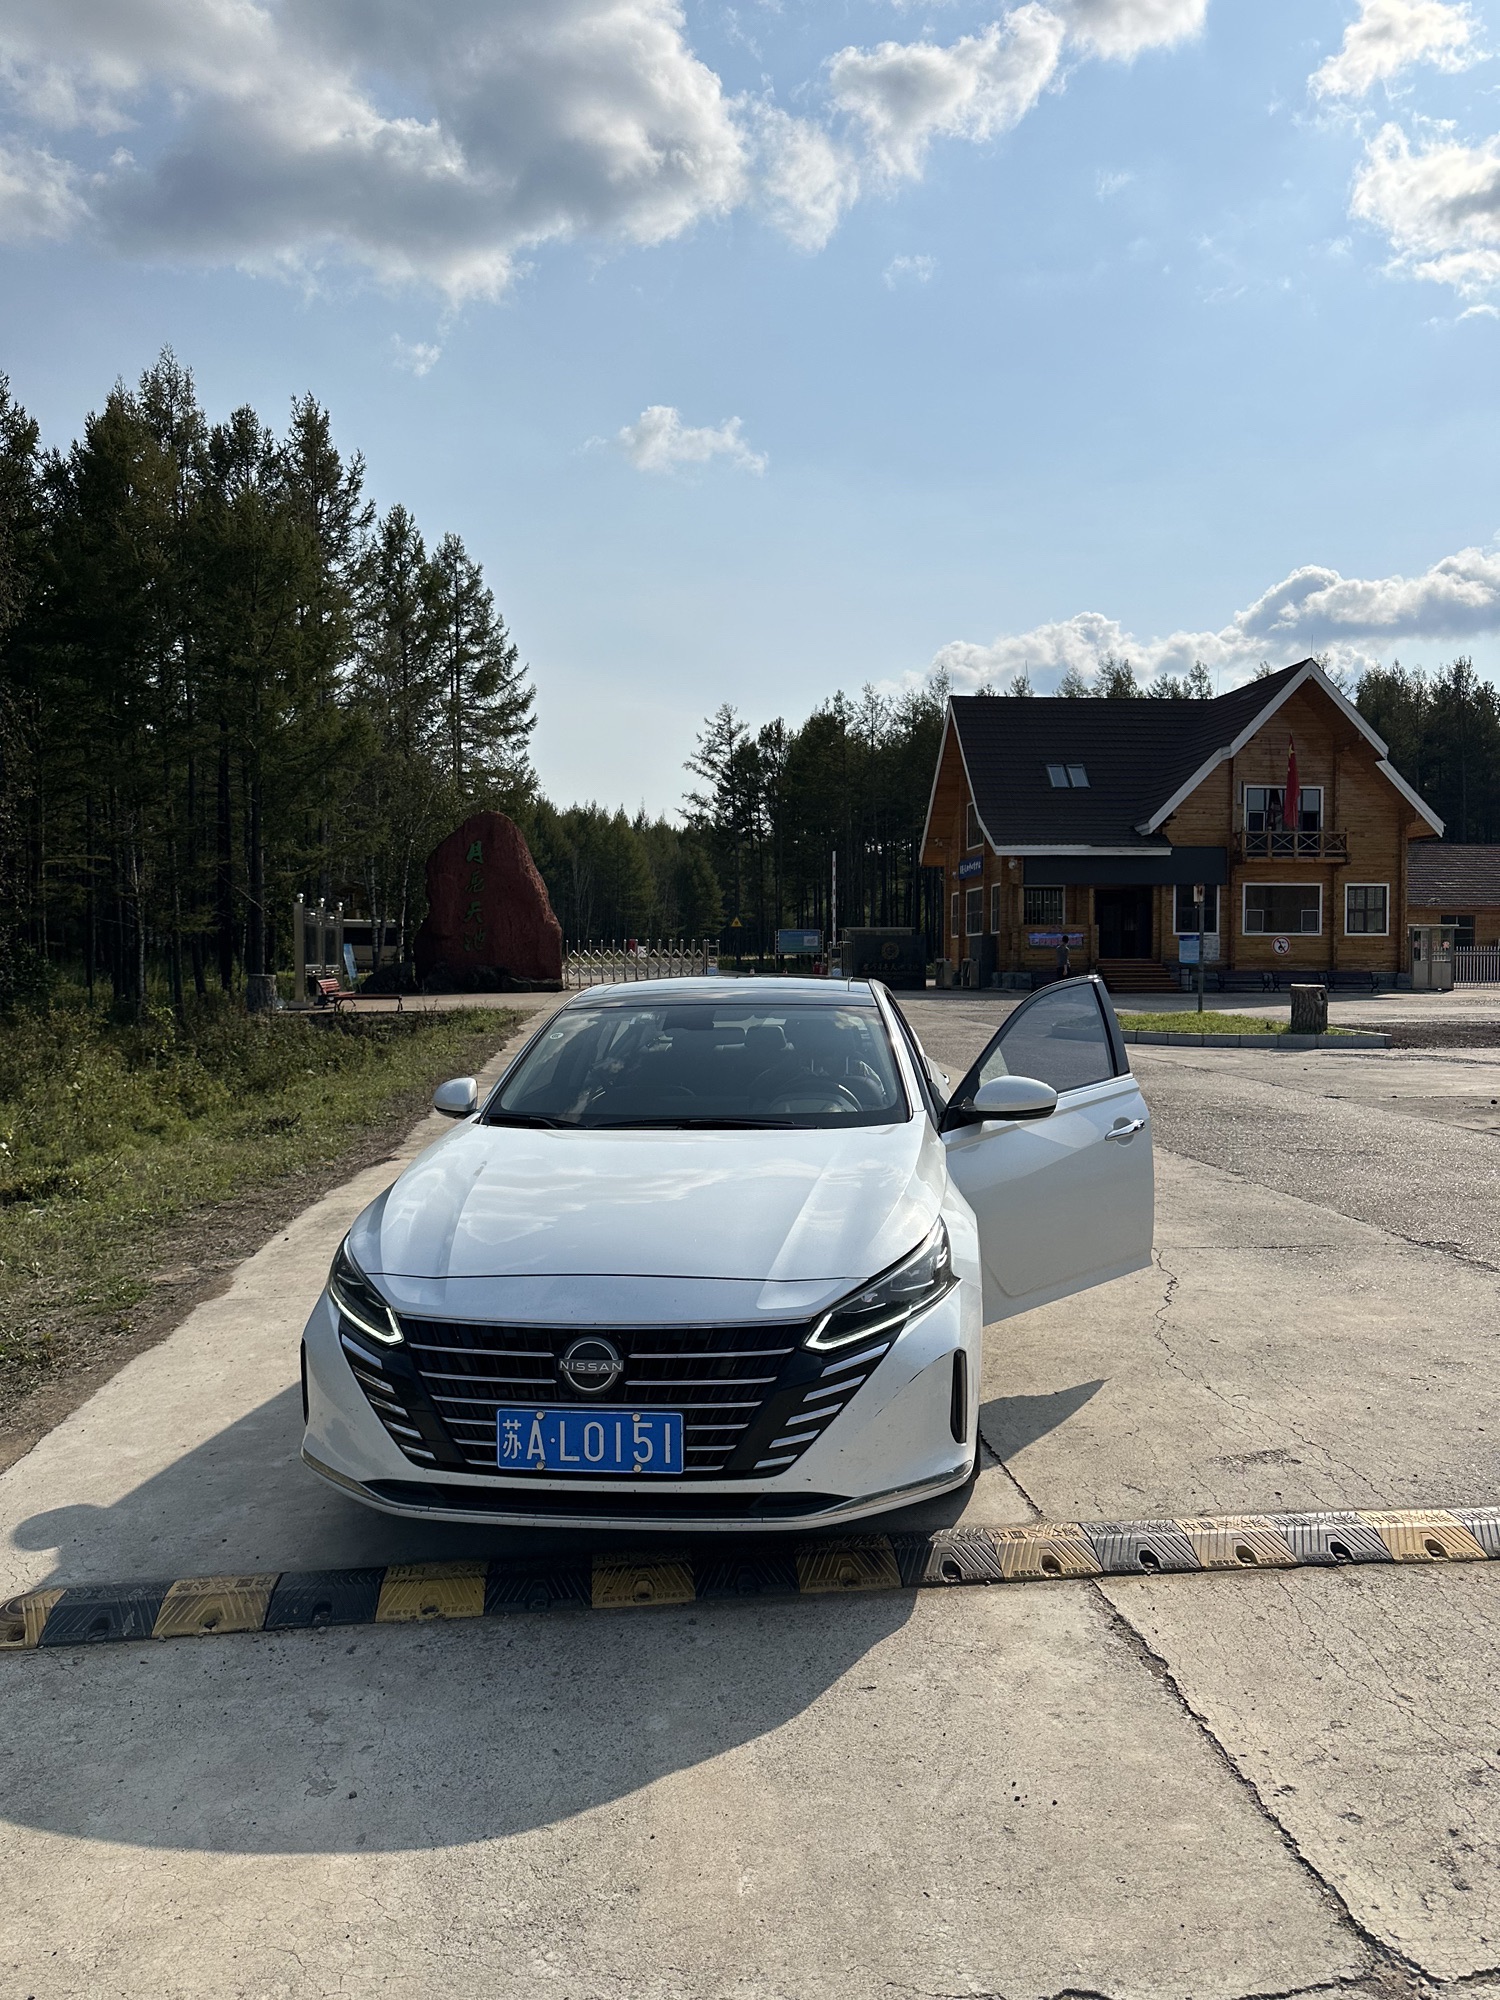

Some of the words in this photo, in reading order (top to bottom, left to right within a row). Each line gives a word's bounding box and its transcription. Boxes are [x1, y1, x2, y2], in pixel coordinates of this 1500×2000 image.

[464, 840, 486, 952] 月亮天池
[560, 1360, 622, 1371] NISSAN
